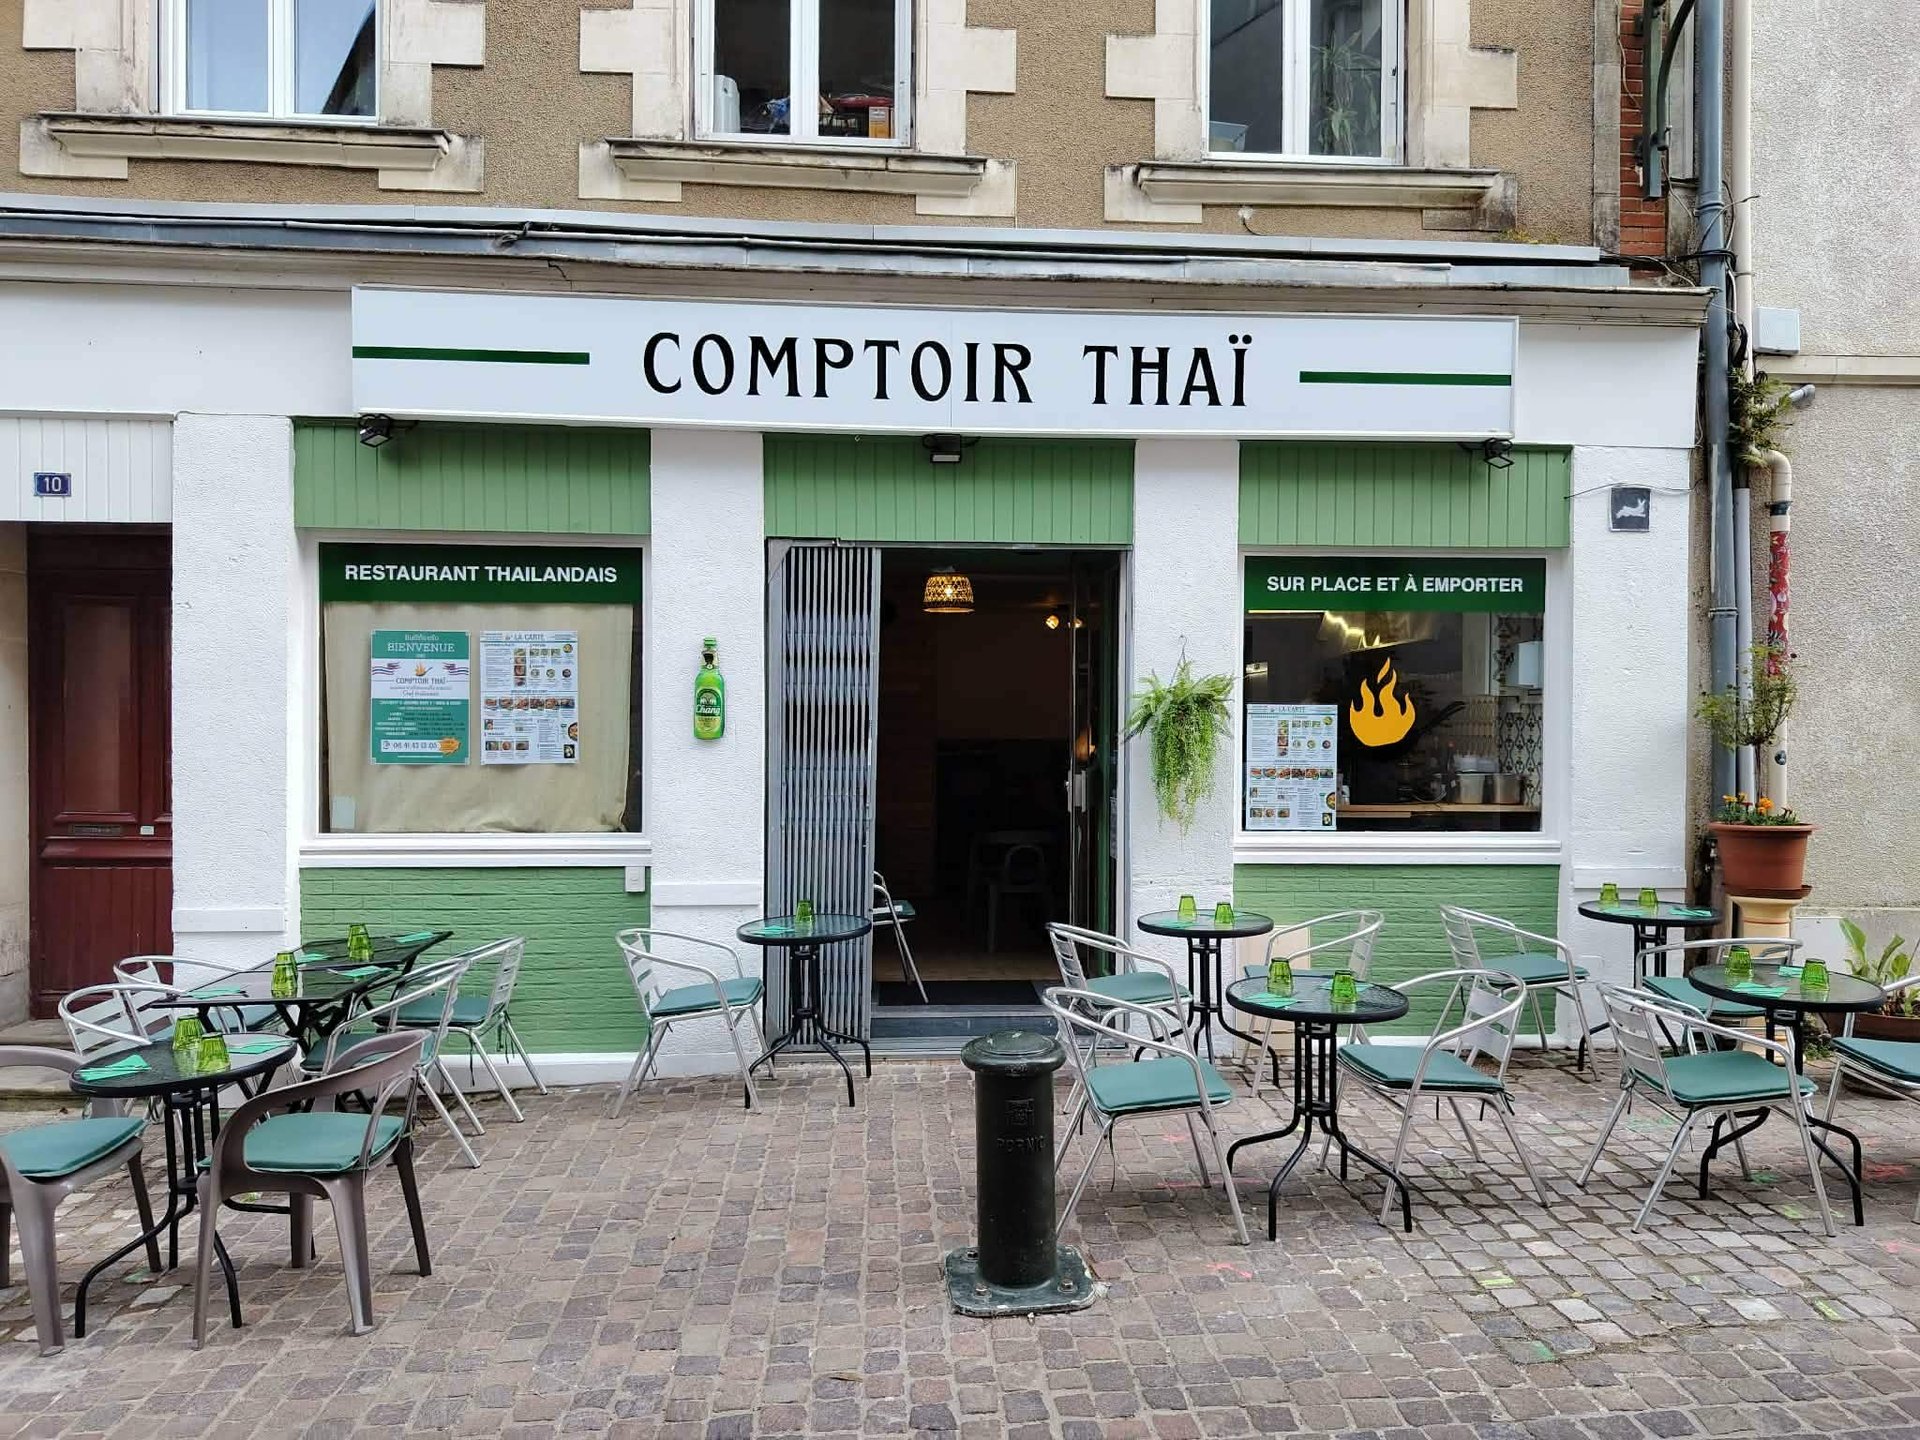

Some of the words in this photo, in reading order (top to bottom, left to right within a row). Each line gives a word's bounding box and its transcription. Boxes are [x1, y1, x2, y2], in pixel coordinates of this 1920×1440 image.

[643, 332, 1033, 404] COMPTOIR
[1081, 334, 1253, 407] THAÏ
[44, 477, 61, 492] 10
[345, 564, 479, 582] RESTAURANT
[485, 565, 618, 583] THAILANDAIS
[1267, 576, 1305, 592] SUR
[1311, 577, 1371, 592] PLACE
[1377, 577, 1399, 592] ET
[1404, 573, 1418, 592] À
[1423, 577, 1523, 592] EMPORTER
[387, 642, 455, 652] BIENVENUE
